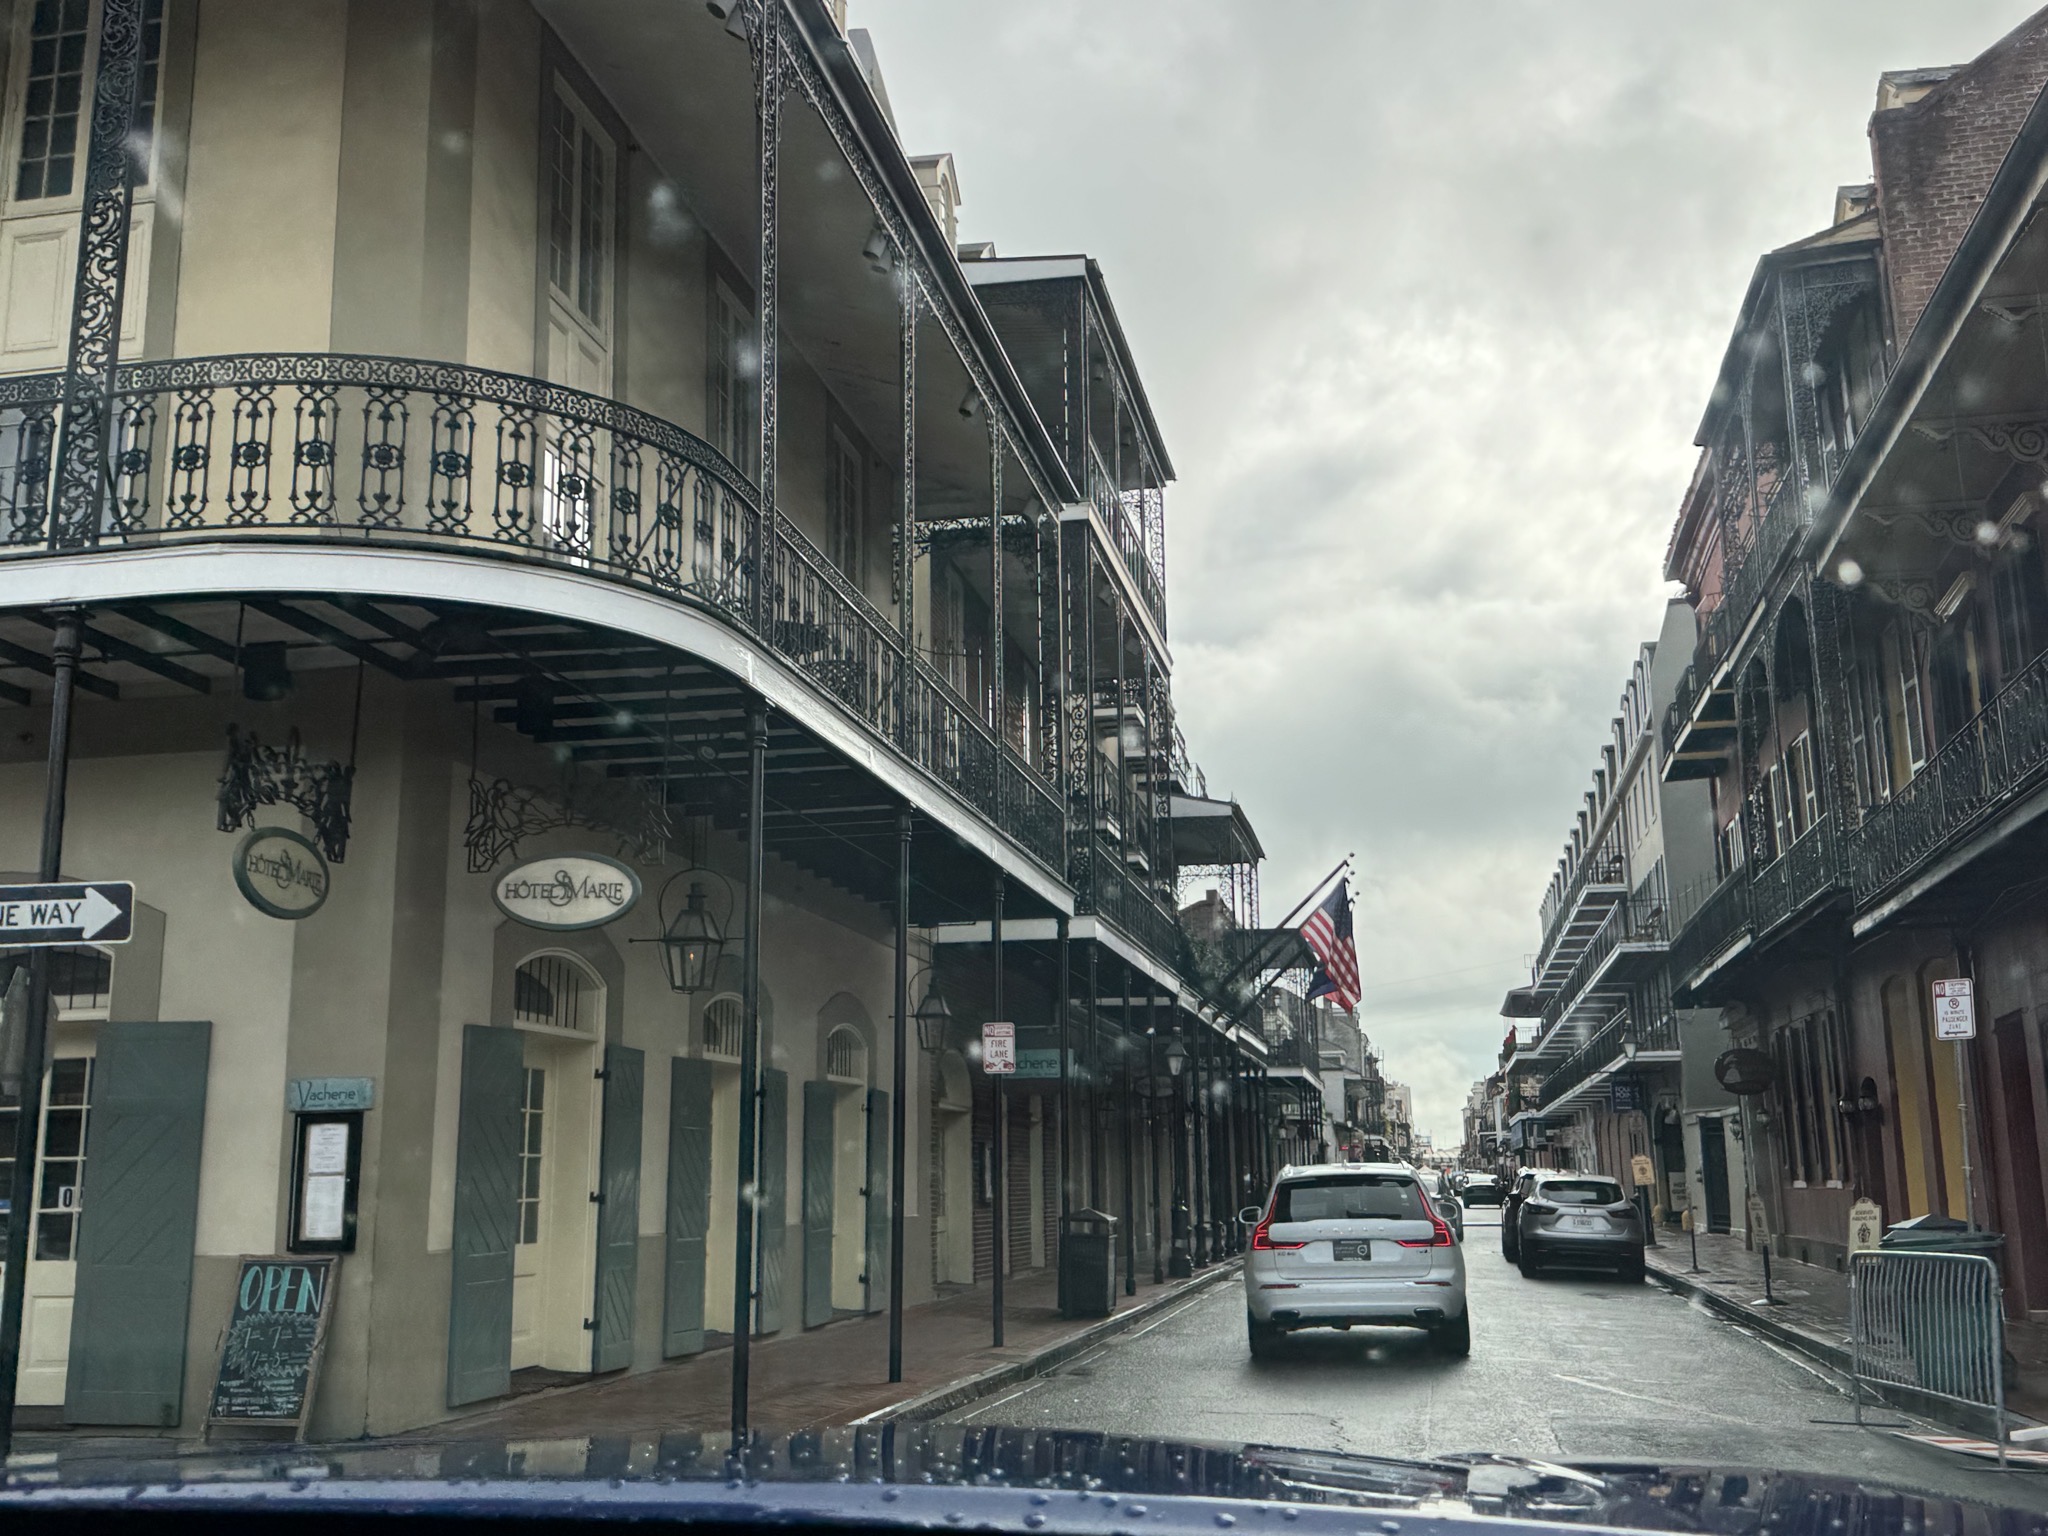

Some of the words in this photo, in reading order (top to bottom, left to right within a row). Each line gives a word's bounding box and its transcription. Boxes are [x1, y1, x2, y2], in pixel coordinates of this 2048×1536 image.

[564, 875, 624, 906] MARIE
[31, 902, 81, 925] WAY
[1935, 983, 1944, 995] NO
[984, 1025, 994, 1037] NO
[990, 1040, 1007, 1048] FIRE
[990, 1050, 1009, 1058] LANE
[240, 1266, 325, 1313] OPEN
